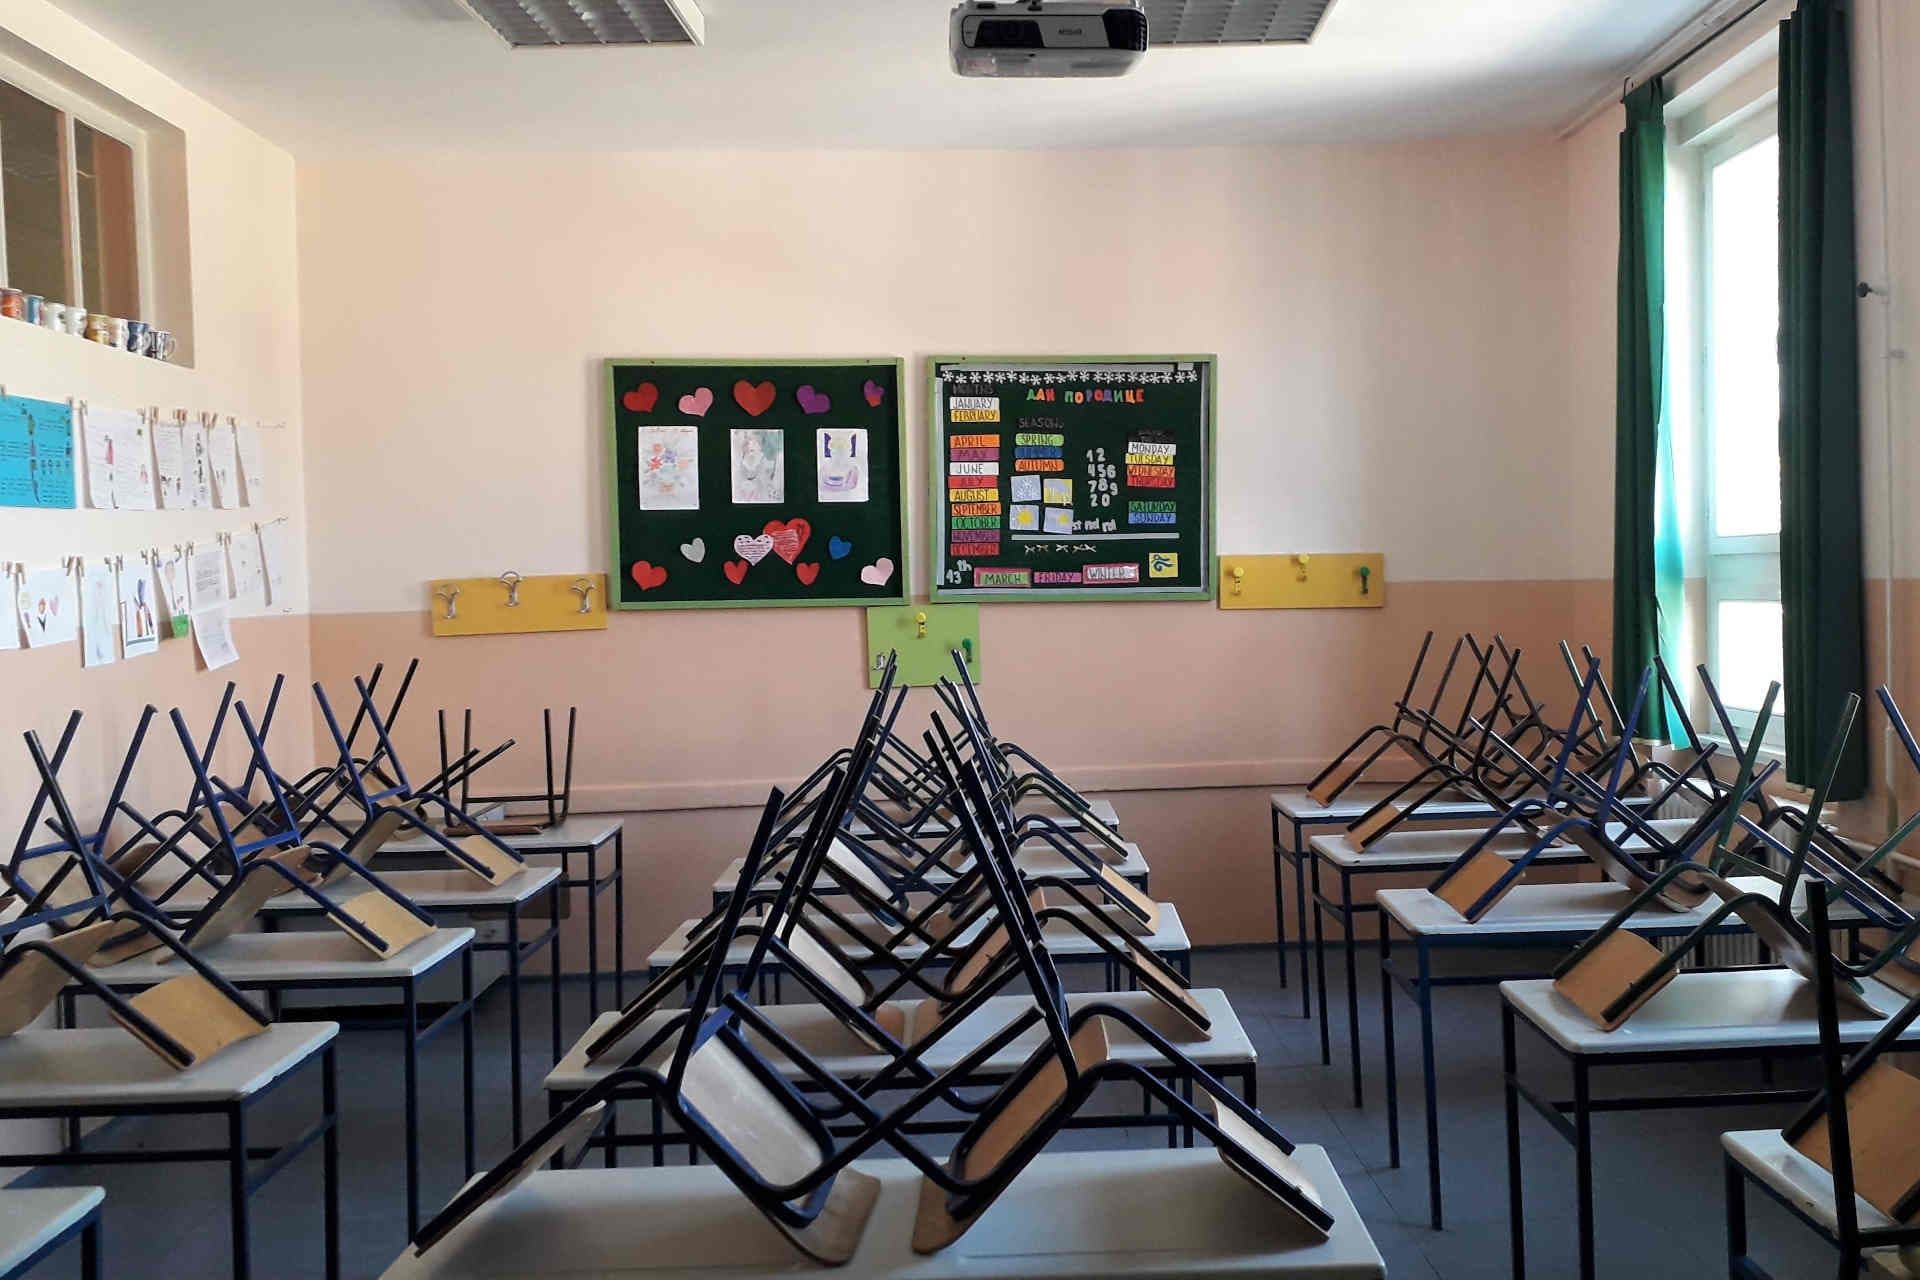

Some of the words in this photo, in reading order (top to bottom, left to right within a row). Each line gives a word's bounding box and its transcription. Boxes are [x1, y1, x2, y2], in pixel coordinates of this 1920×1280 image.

[1064, 389, 1144, 404] ПОРОДИЦЕ
[953, 399, 993, 409] JANUARY
[955, 437, 984, 447] APRIL
[1131, 442, 1170, 454] MONDAY
[1130, 453, 1170, 464] TUESDAY
[957, 463, 984, 474] JUNE
[954, 490, 988, 501] AUGUST
[1134, 513, 1172, 524] SUNDAY
[1085, 518, 1099, 530] nd
[1102, 519, 1117, 532] rd
[985, 573, 1021, 584] MARCH
